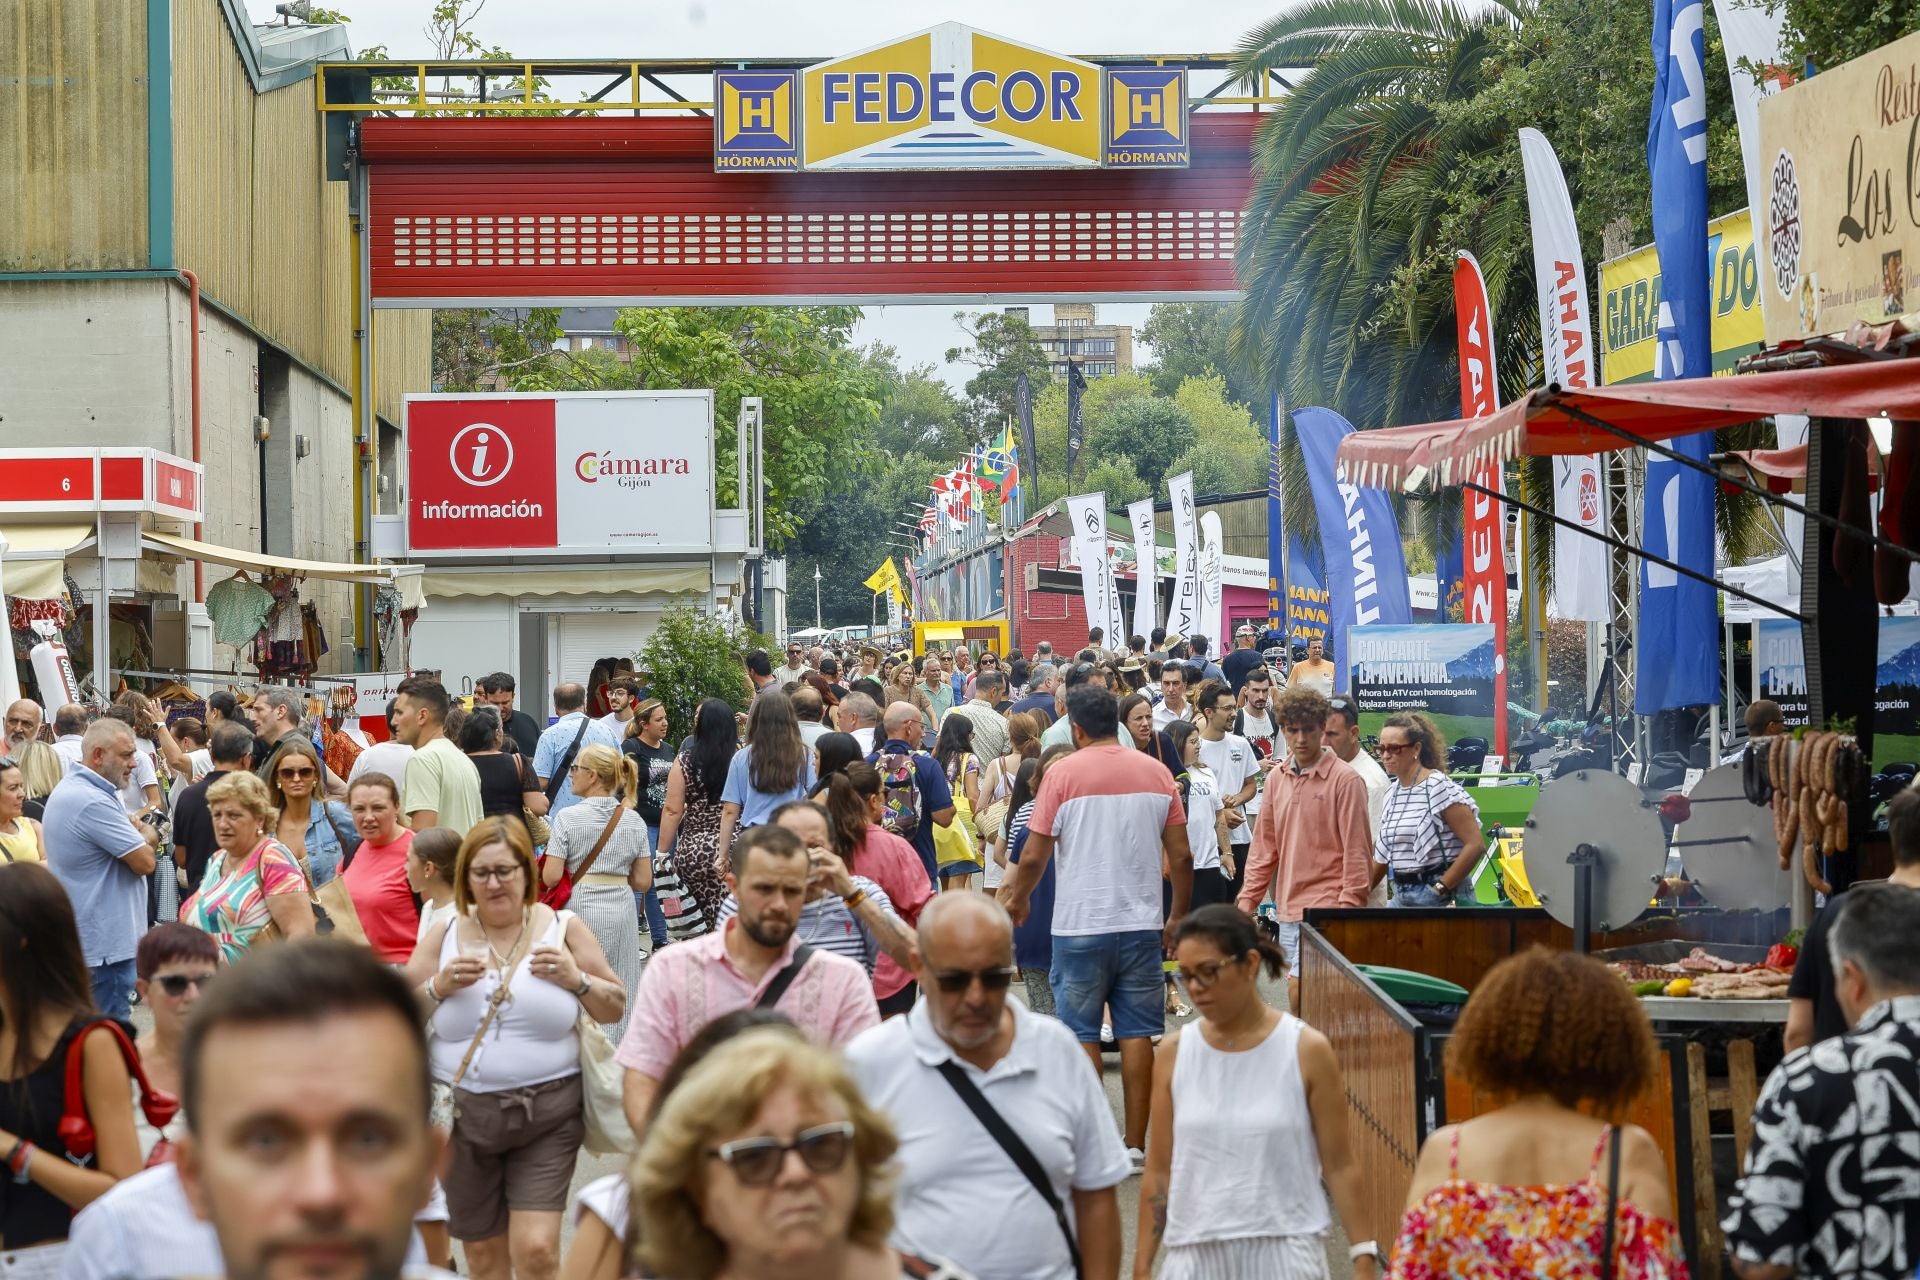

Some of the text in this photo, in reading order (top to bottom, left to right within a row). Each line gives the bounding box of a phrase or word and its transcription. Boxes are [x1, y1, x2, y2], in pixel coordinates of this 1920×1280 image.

[822, 70, 1084, 124] FEDECOR
[1875, 64, 1920, 128] Rest
[717, 153, 798, 168] HÖRMANN
[1107, 149, 1189, 164] HÖRMANN
[1837, 133, 1898, 249] Los
[1606, 243, 1762, 354] GARA DO
[62, 477, 71, 492] 6
[618, 476, 652, 491] Gijón
[422, 498, 543, 519] información
[1242, 567, 1268, 577] también
[1359, 639, 1430, 661] COMPARTE
[1359, 662, 1453, 685] LA AVENTURA.
[363, 688, 399, 696] DRINK
[1358, 688, 1382, 697] Ahora
[1383, 689, 1392, 697] tu
[1392, 689, 1409, 697] ATV
[1424, 688, 1477, 699] homologación
[1359, 699, 1429, 709] biplaza disponible.
[1873, 699, 1909, 712] ogación
